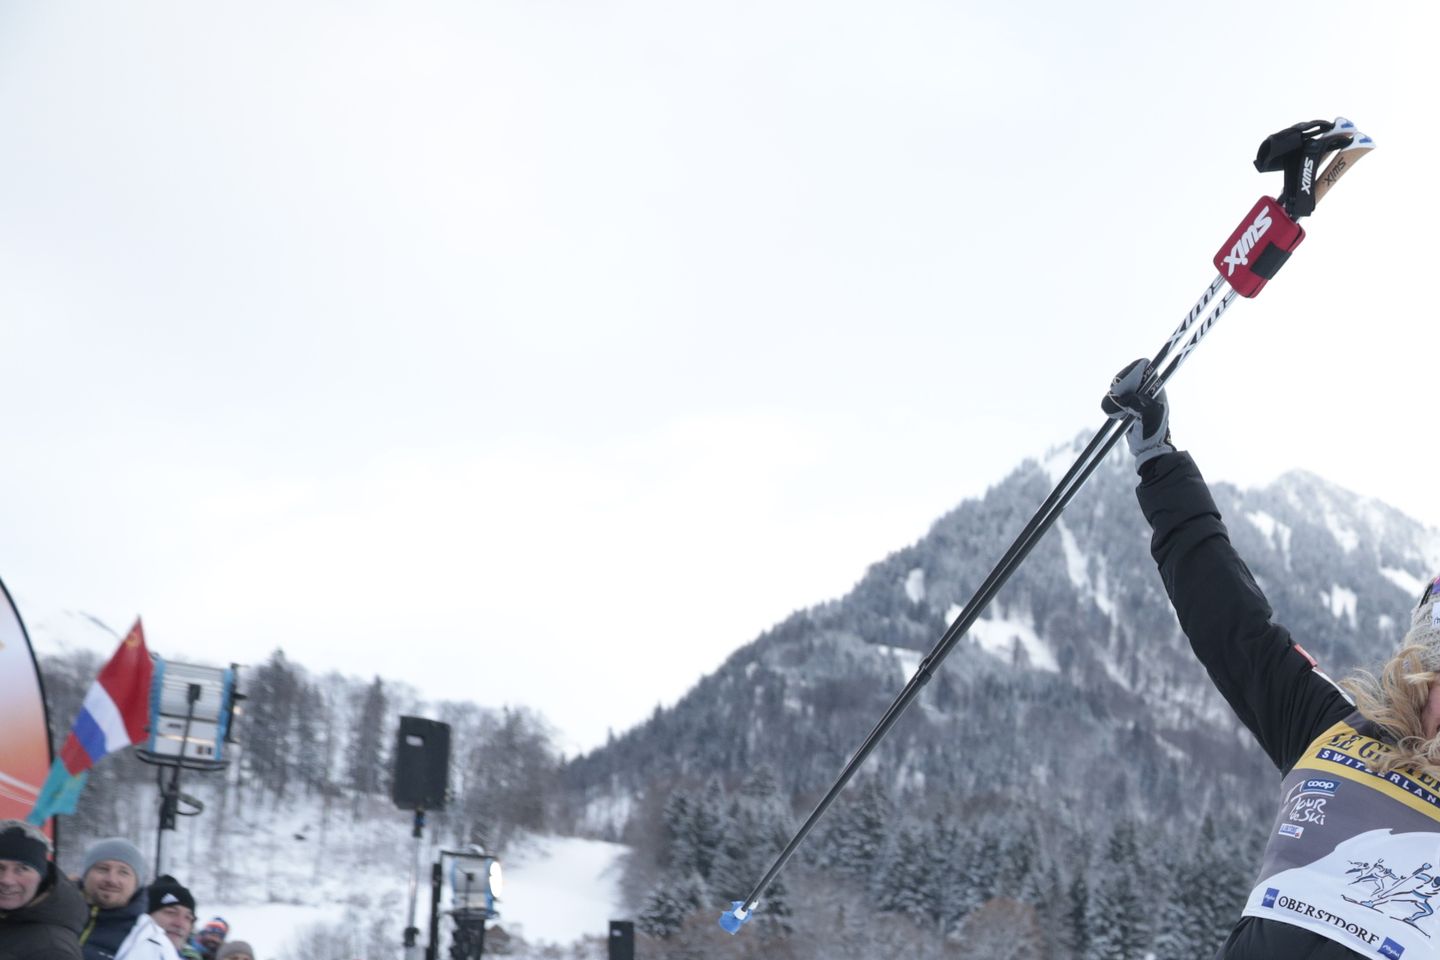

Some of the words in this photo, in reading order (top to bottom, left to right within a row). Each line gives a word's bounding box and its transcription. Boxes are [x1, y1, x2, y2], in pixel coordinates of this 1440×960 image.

[1301, 157, 1313, 195] SWIX
[1307, 780, 1334, 789] coop
[1278, 896, 1380, 945] OBERSTDORF
